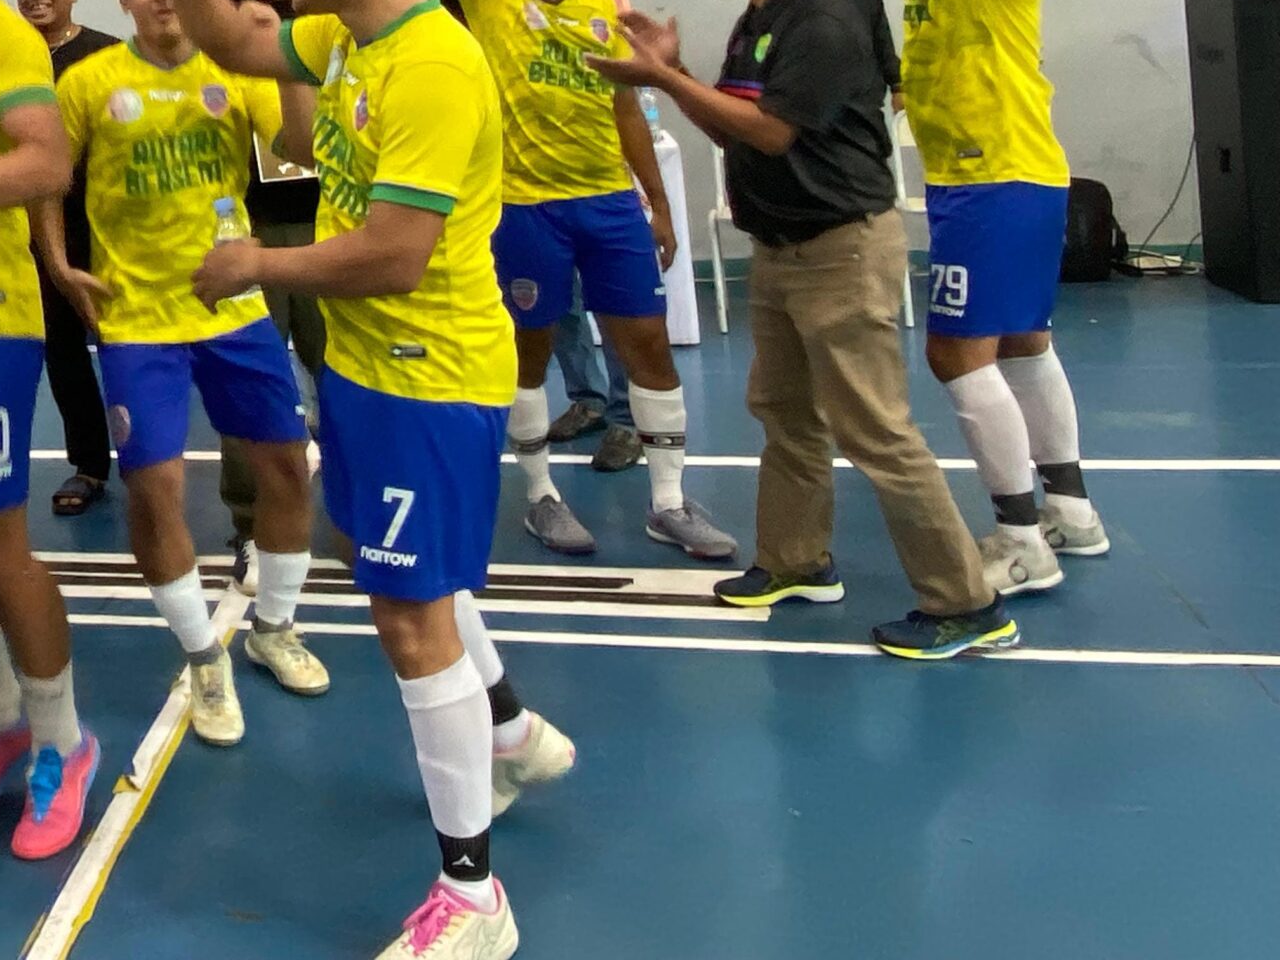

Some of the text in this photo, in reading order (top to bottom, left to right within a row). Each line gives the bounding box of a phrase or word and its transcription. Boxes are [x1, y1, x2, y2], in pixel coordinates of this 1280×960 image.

[931, 263, 968, 306] 79
[382, 486, 414, 548] 7
[360, 545, 418, 567] narrow
